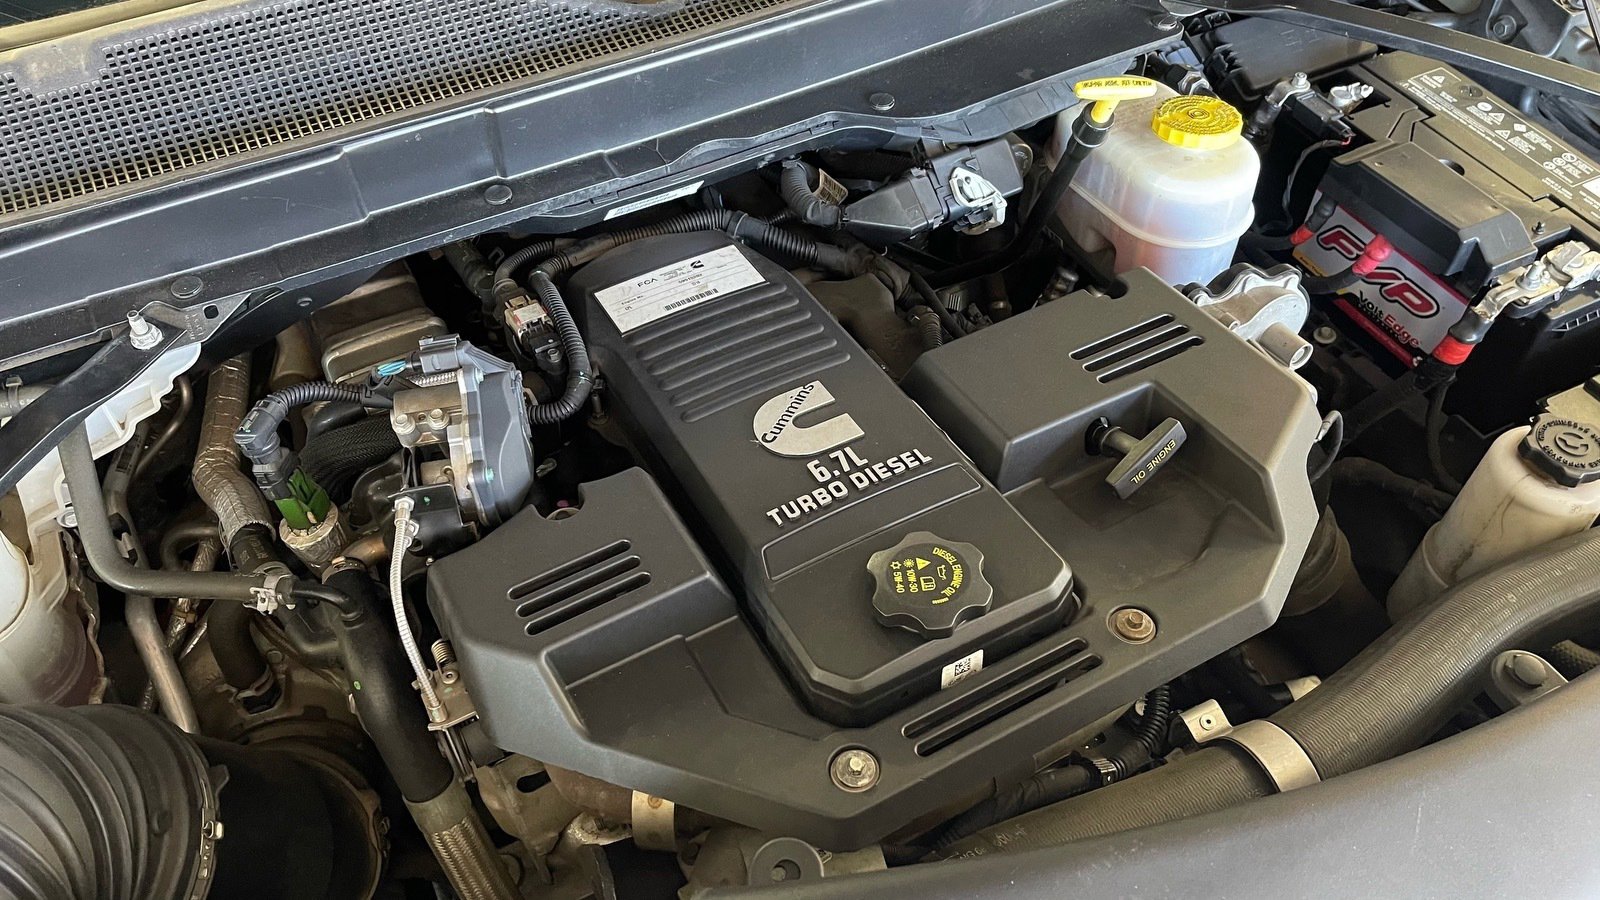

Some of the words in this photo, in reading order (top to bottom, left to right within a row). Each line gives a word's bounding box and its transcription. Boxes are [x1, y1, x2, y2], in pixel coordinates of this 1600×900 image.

[637, 277, 658, 288] FCA
[761, 383, 814, 444] Cummins
[807, 447, 868, 483] 6.7L
[1146, 439, 1177, 471] ENGINE
[766, 481, 849, 527] TURBO
[849, 449, 933, 491] DIESEL
[1130, 470, 1146, 484] OIL
[932, 547, 957, 565] DIESEL
[893, 571, 905, 594] 5W-40
[906, 569, 919, 593] 10W-30
[950, 564, 964, 589] ENGINE
[940, 586, 955, 597] OIL
